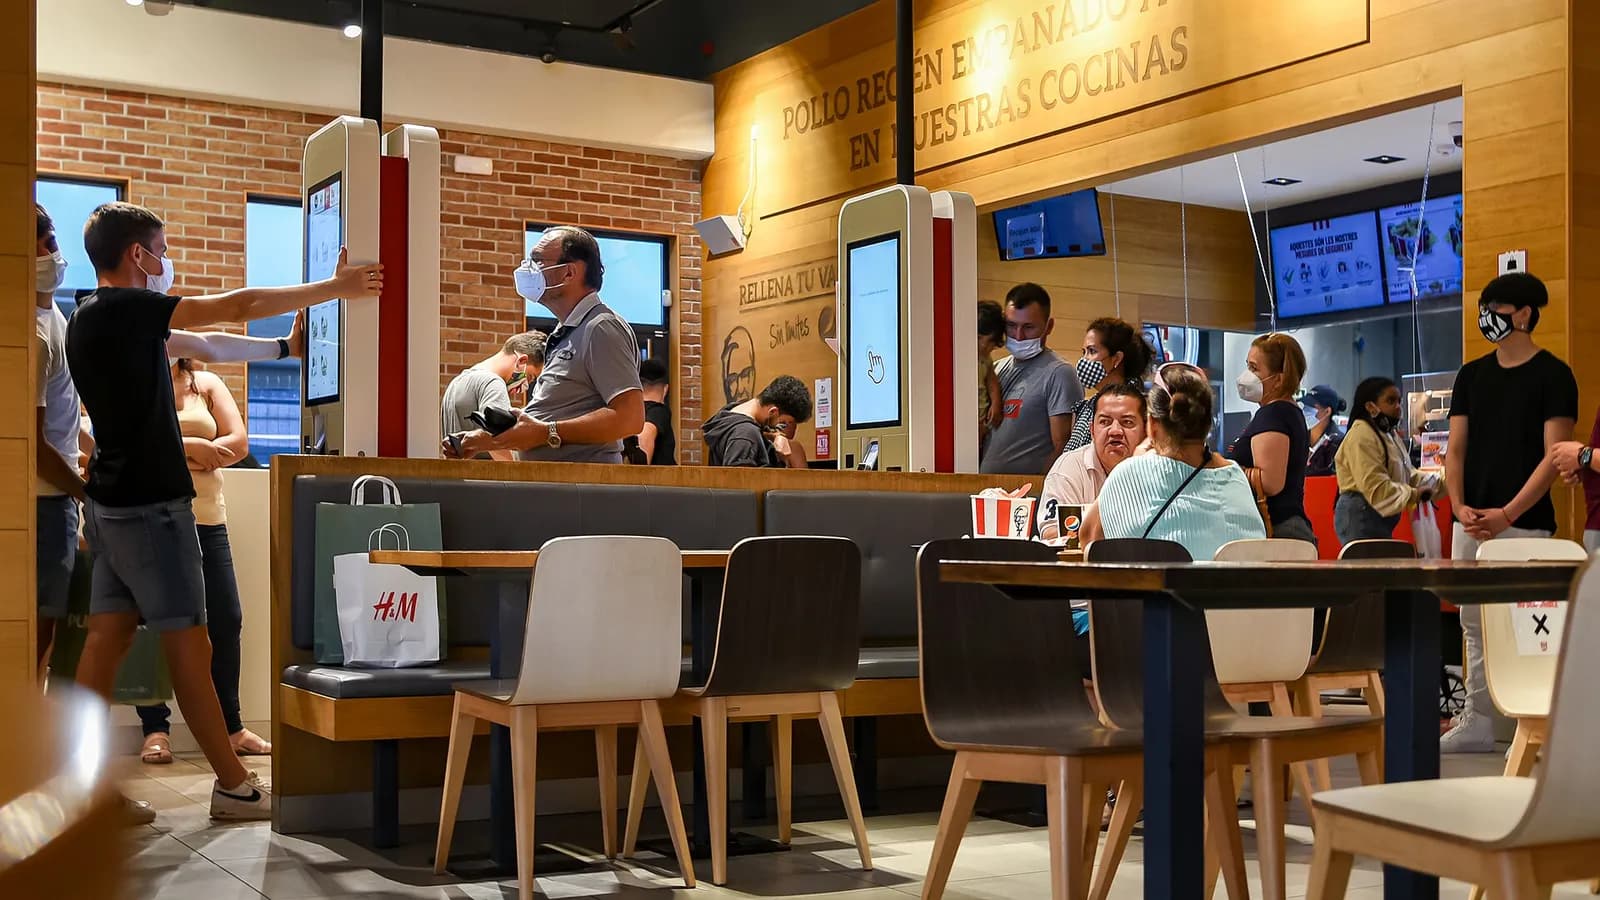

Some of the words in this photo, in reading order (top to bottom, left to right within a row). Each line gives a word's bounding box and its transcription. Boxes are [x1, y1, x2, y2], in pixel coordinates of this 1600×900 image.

[783, 86, 849, 140] POLLO
[856, 48, 944, 115] RECÉN
[849, 129, 881, 171] EN
[1039, 25, 1189, 110] COCINAS
[739, 275, 794, 306] RELLENA
[796, 268, 815, 294] TU
[373, 591, 418, 623] H&M
